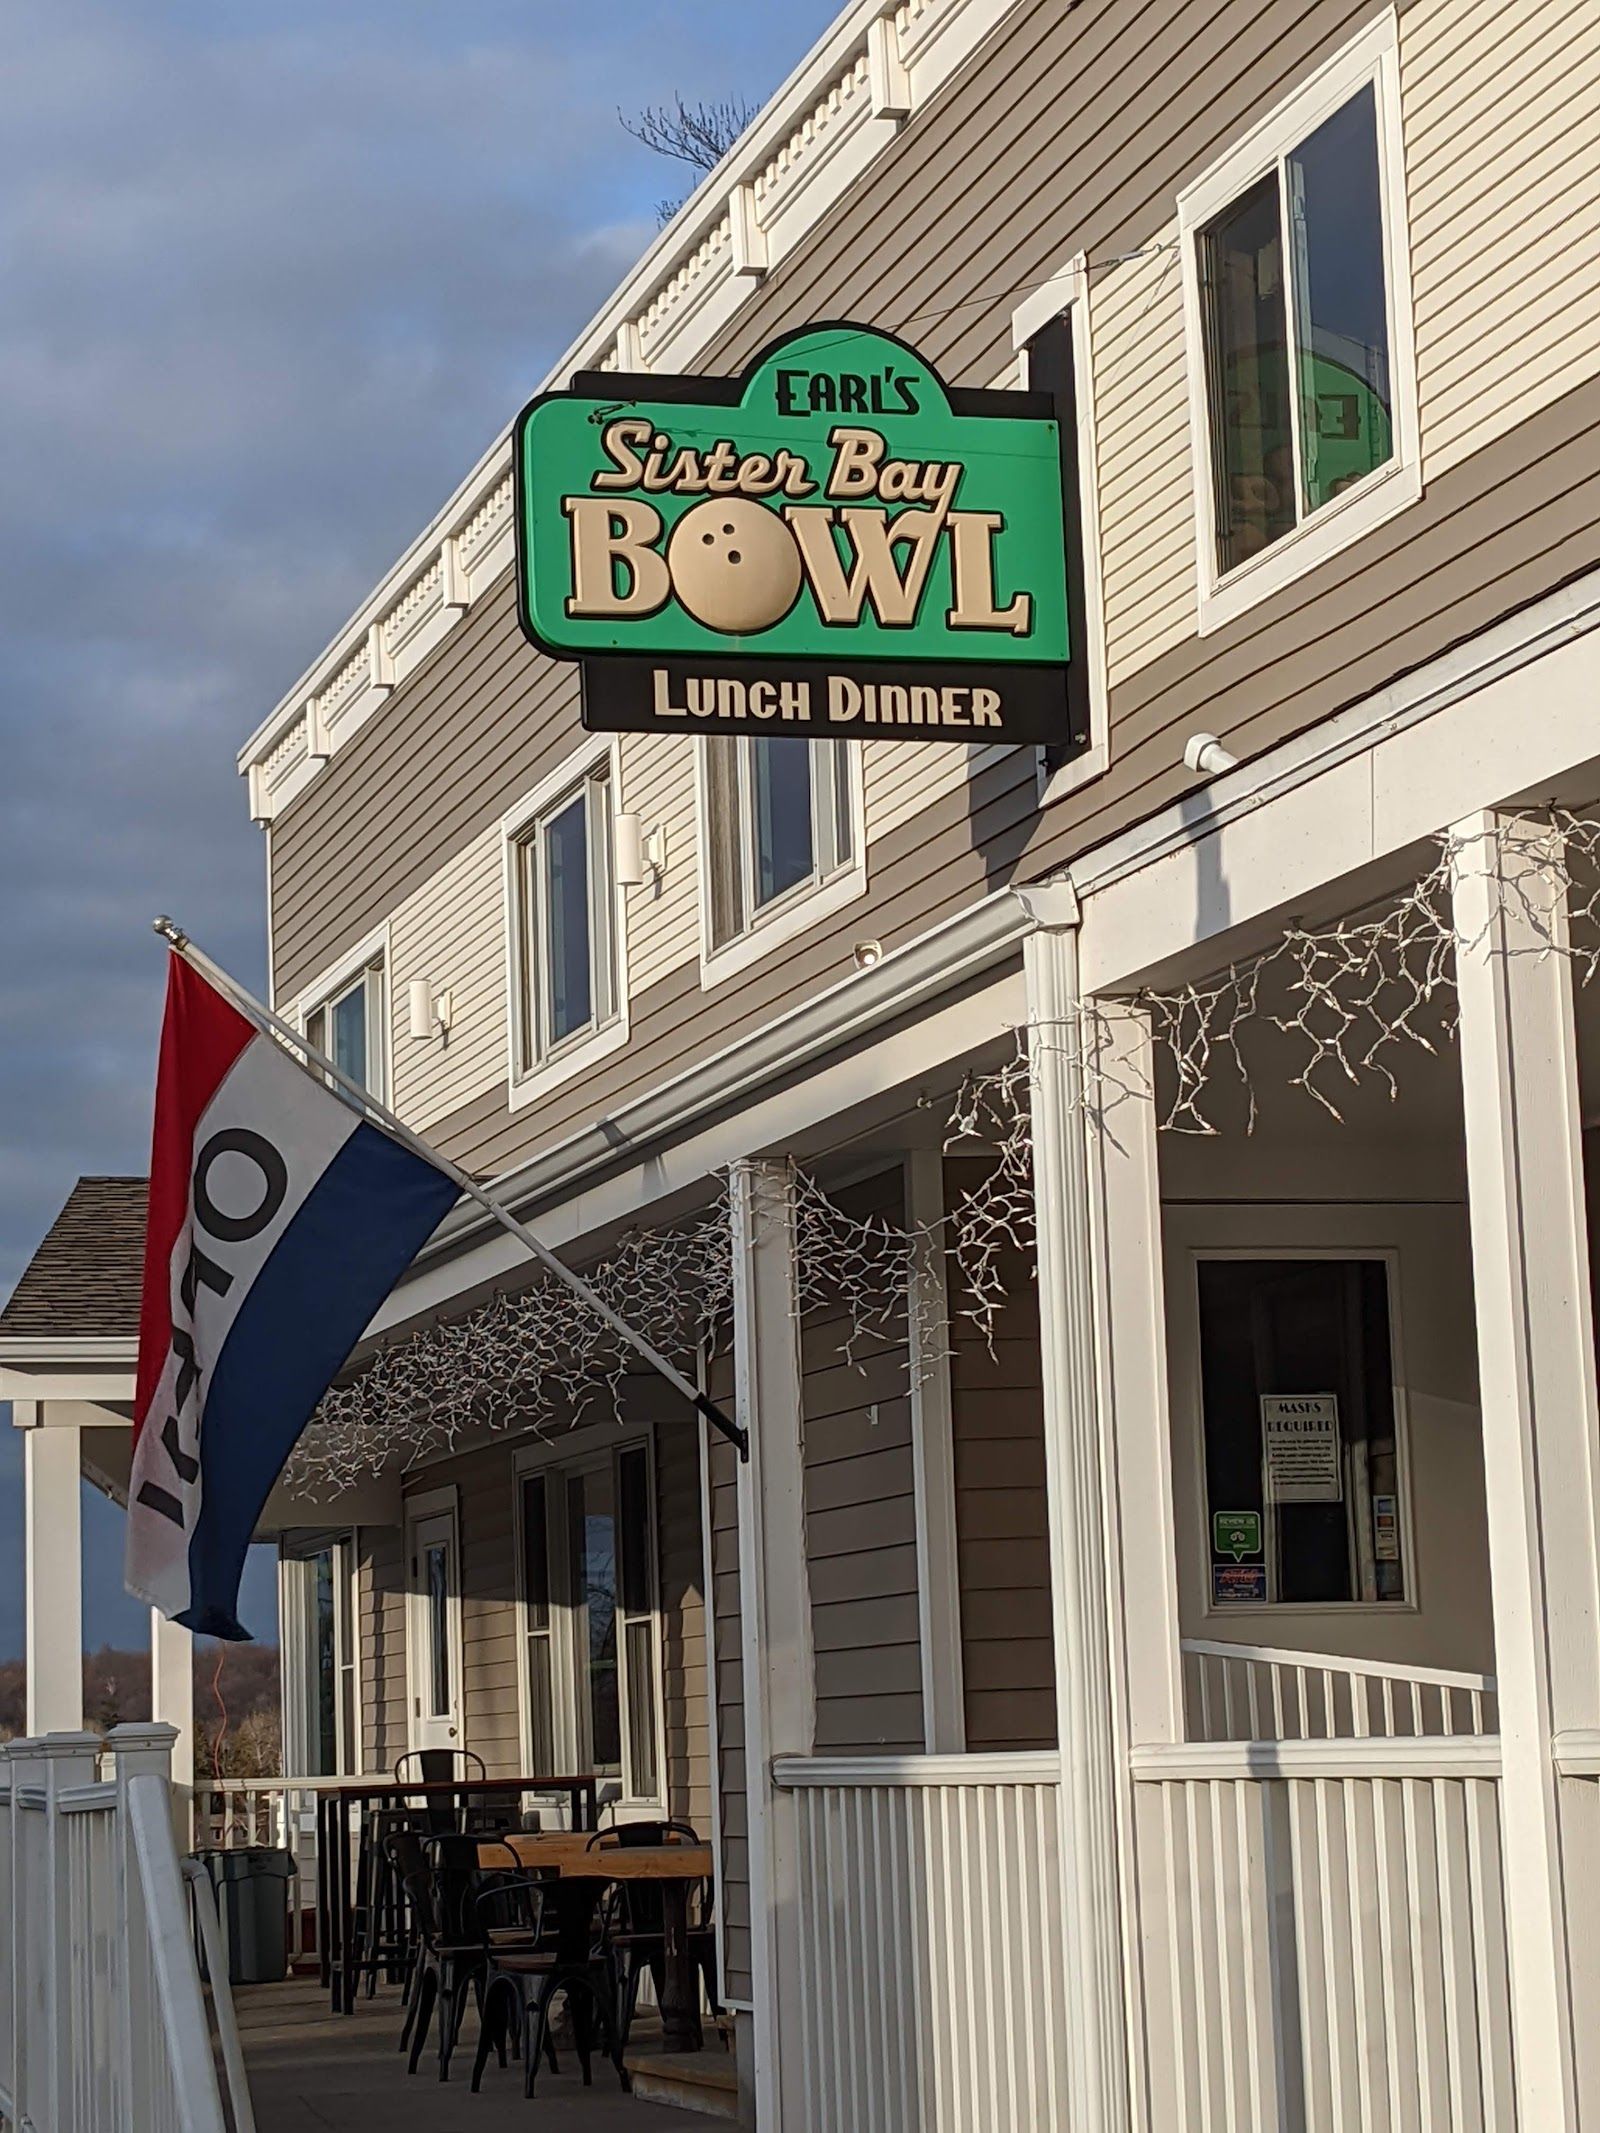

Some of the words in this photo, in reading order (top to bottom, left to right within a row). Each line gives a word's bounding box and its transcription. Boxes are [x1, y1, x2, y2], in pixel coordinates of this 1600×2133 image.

[775, 367, 920, 418] EARL'S
[592, 419, 817, 494] Sister
[828, 427, 963, 512] Bay
[564, 496, 1030, 635] BOWL
[652, 669, 811, 721] LUNCH
[827, 675, 1003, 728] DINNER
[1267, 1420, 1334, 1433] REQUIRED
[1278, 1402, 1322, 1415] MASKS
